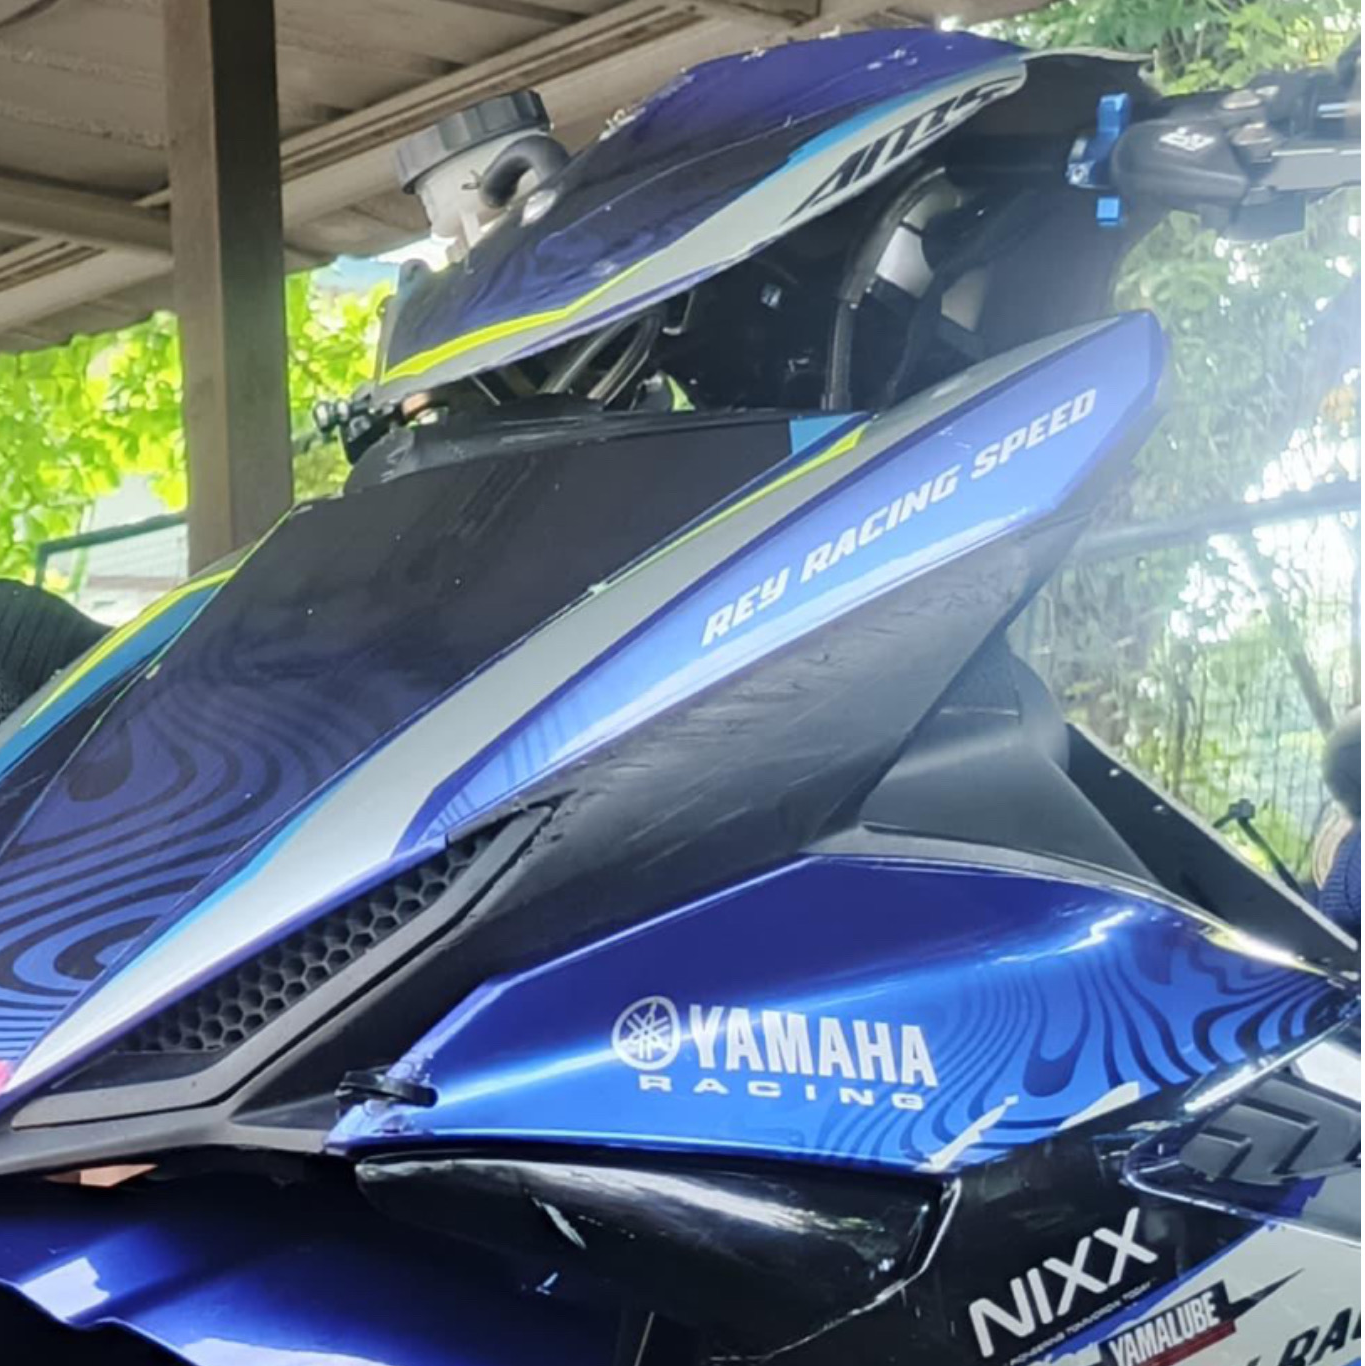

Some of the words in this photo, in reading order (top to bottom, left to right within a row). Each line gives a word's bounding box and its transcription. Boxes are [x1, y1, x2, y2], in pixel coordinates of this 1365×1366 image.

[701, 567, 789, 647] REY
[800, 464, 961, 583] RACING
[971, 389, 1097, 479] SPEED
[638, 1074, 926, 1110] RACING
[690, 1004, 938, 1087] YAMAHA
[969, 1207, 1158, 1358] NIXX
